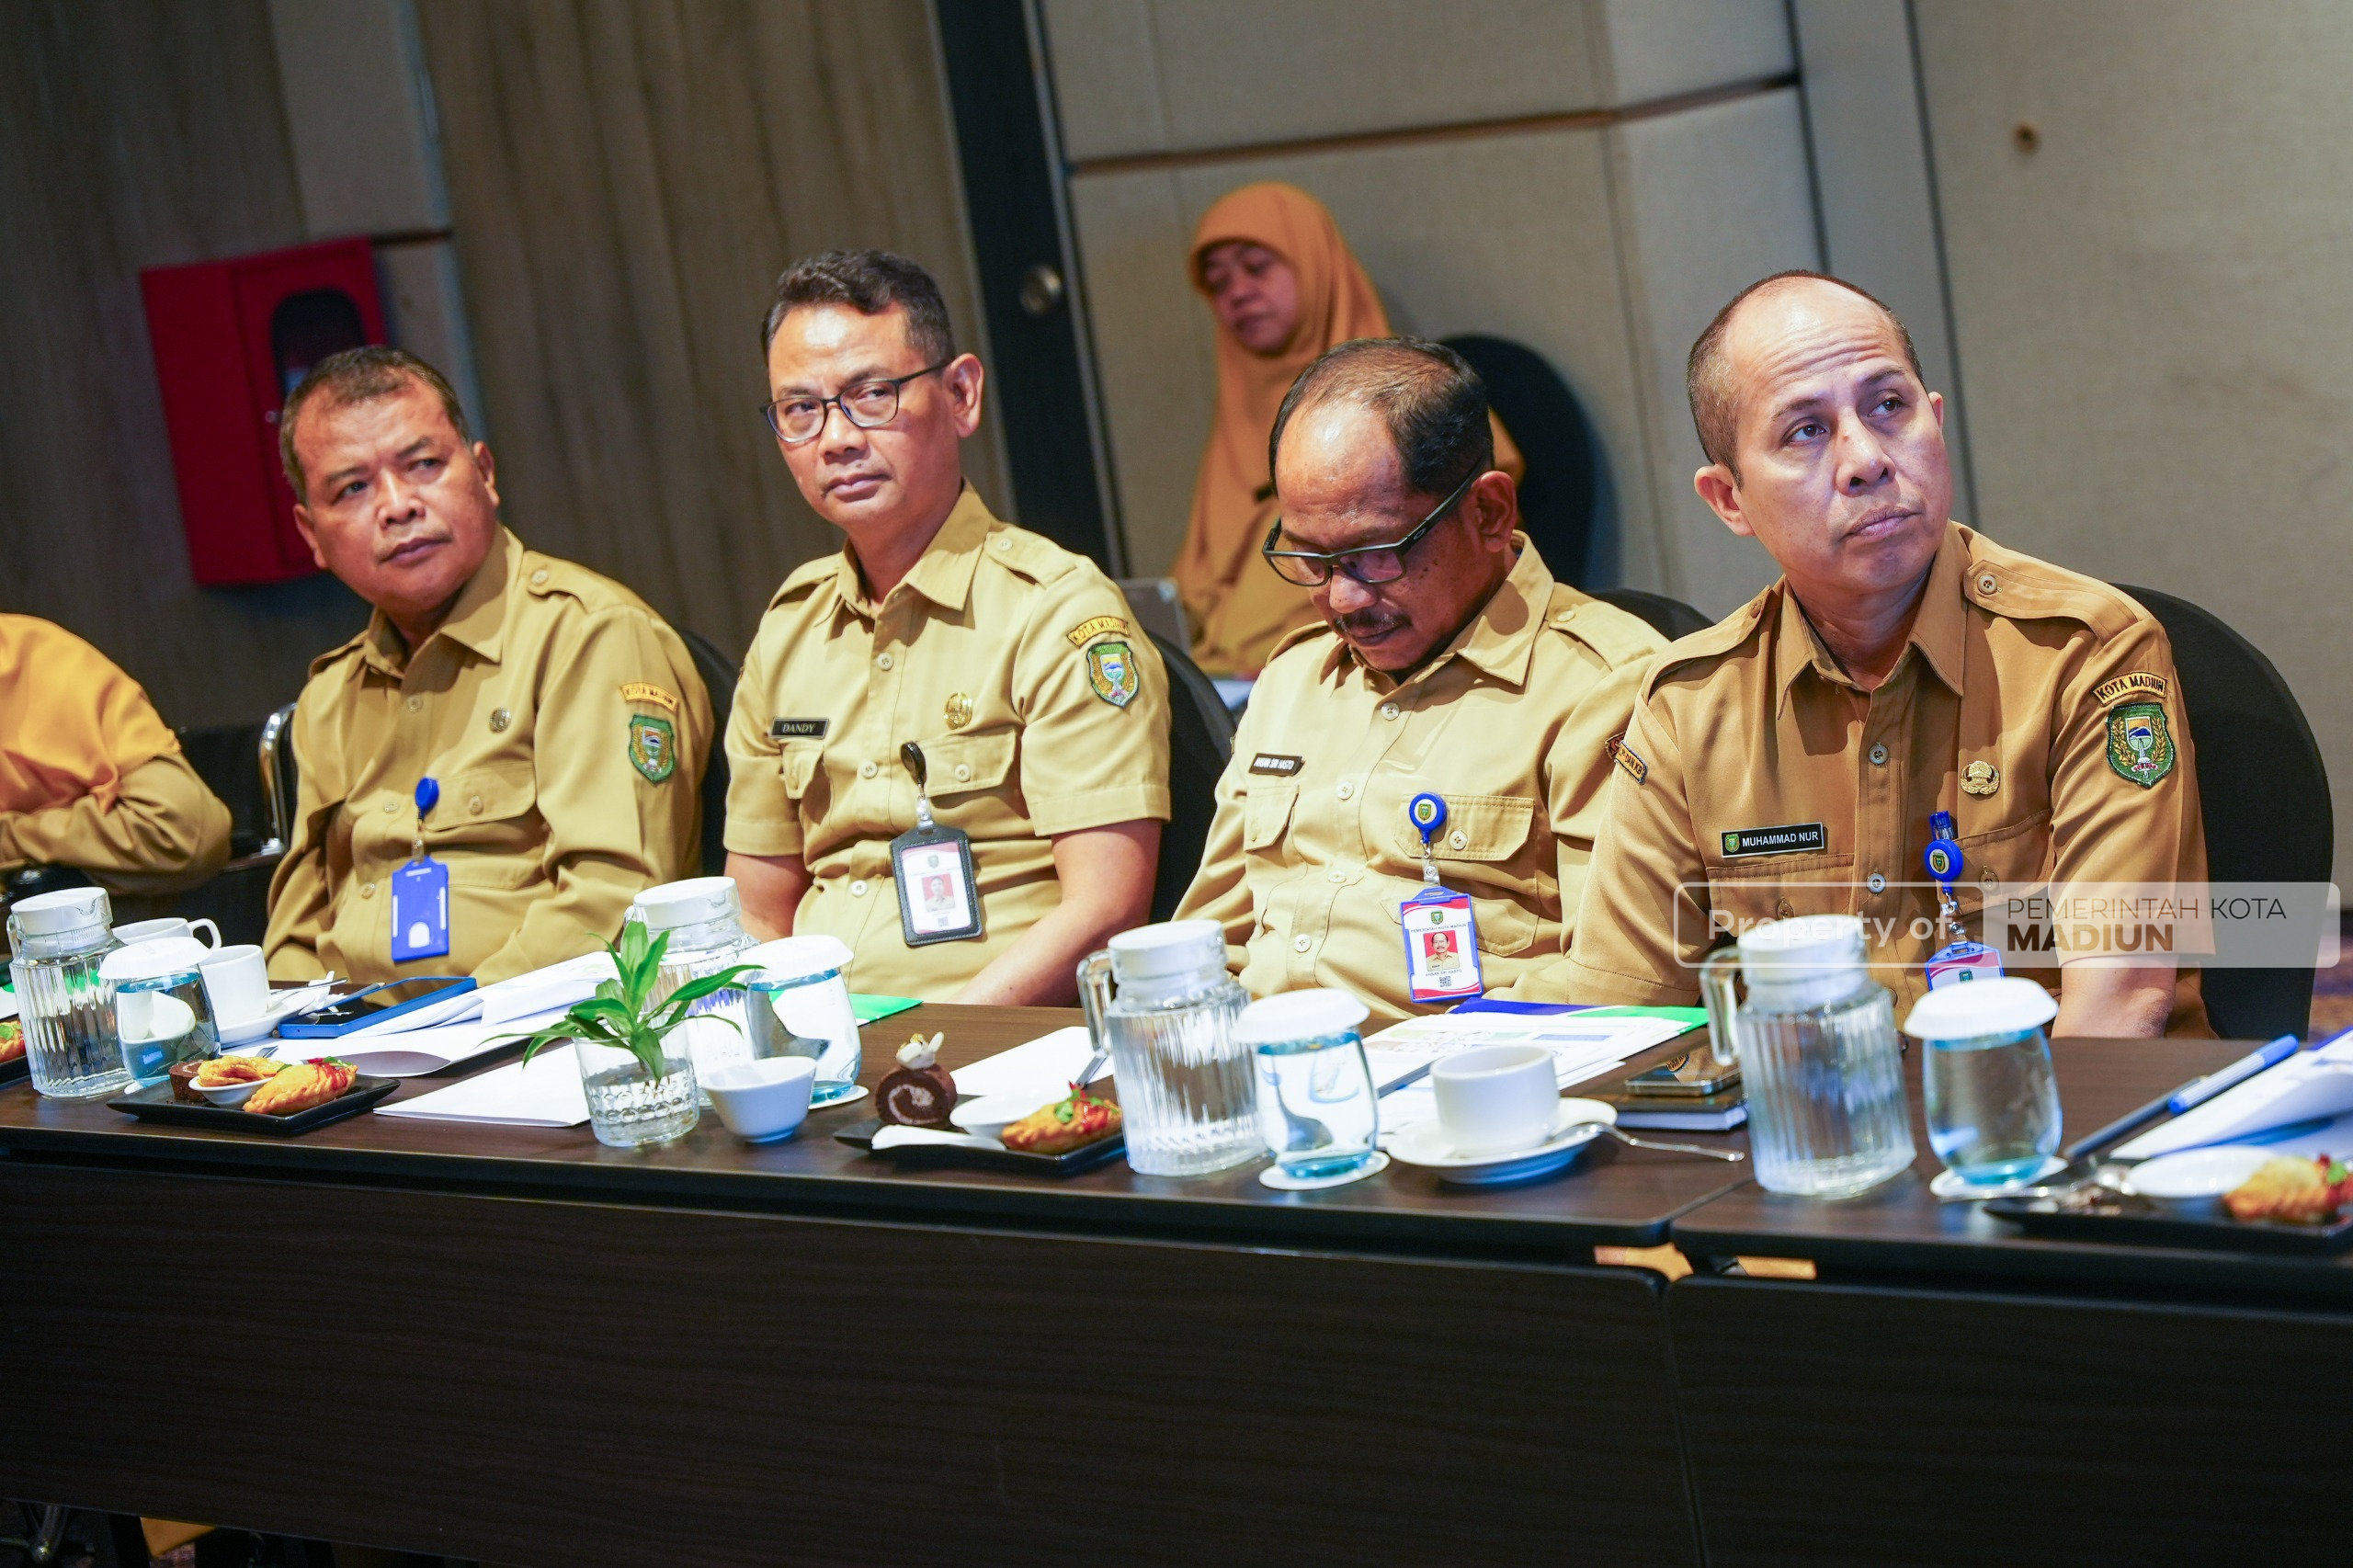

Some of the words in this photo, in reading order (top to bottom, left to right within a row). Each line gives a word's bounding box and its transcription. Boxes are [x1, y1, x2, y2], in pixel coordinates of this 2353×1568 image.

[2097, 681, 2129, 700] KOTA
[2129, 675, 2165, 690] MADIUN
[782, 723, 815, 733] DANDY
[1742, 834, 1797, 847] MUHAMMAD
[1799, 831, 1819, 842] NUR
